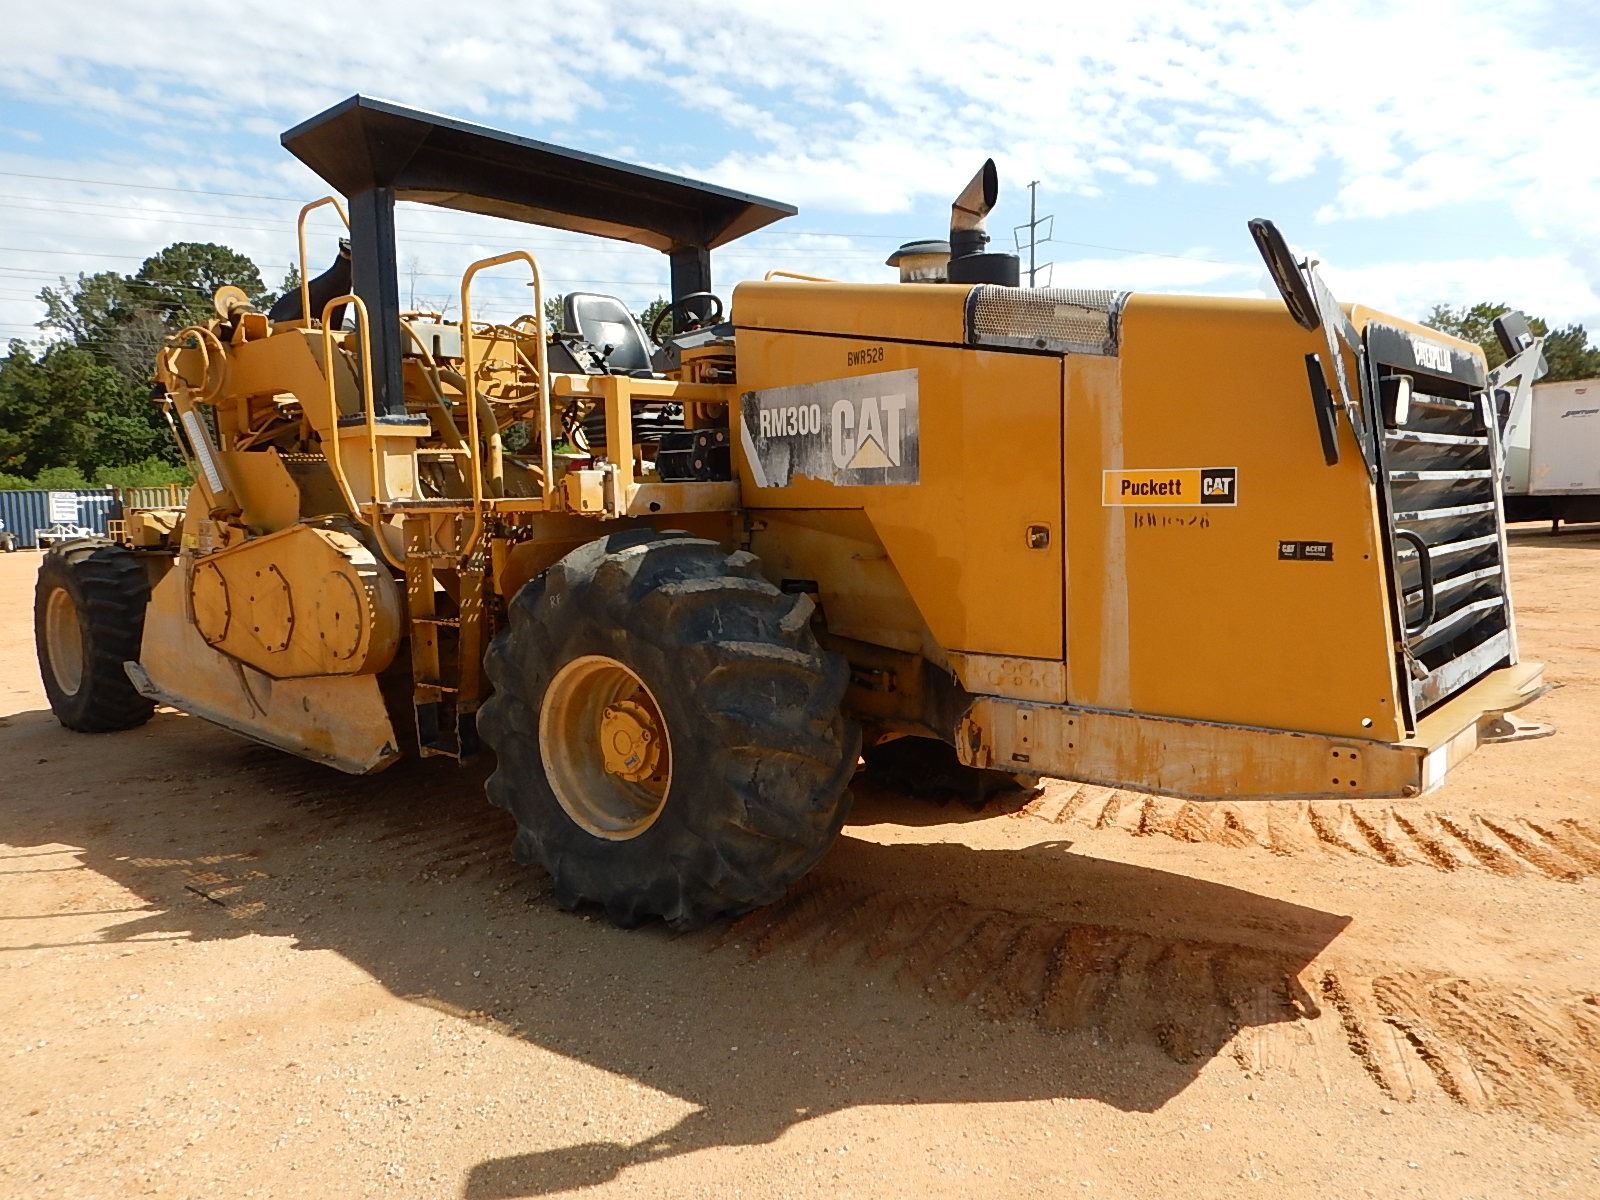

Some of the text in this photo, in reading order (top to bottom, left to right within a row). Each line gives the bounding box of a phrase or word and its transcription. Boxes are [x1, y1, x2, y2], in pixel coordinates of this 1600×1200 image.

[847, 347, 884, 367] BWR528
[760, 394, 906, 469] RM300 CAT
[1121, 477, 1234, 496] Puckett CAT
[1281, 544, 1296, 553] CAT
